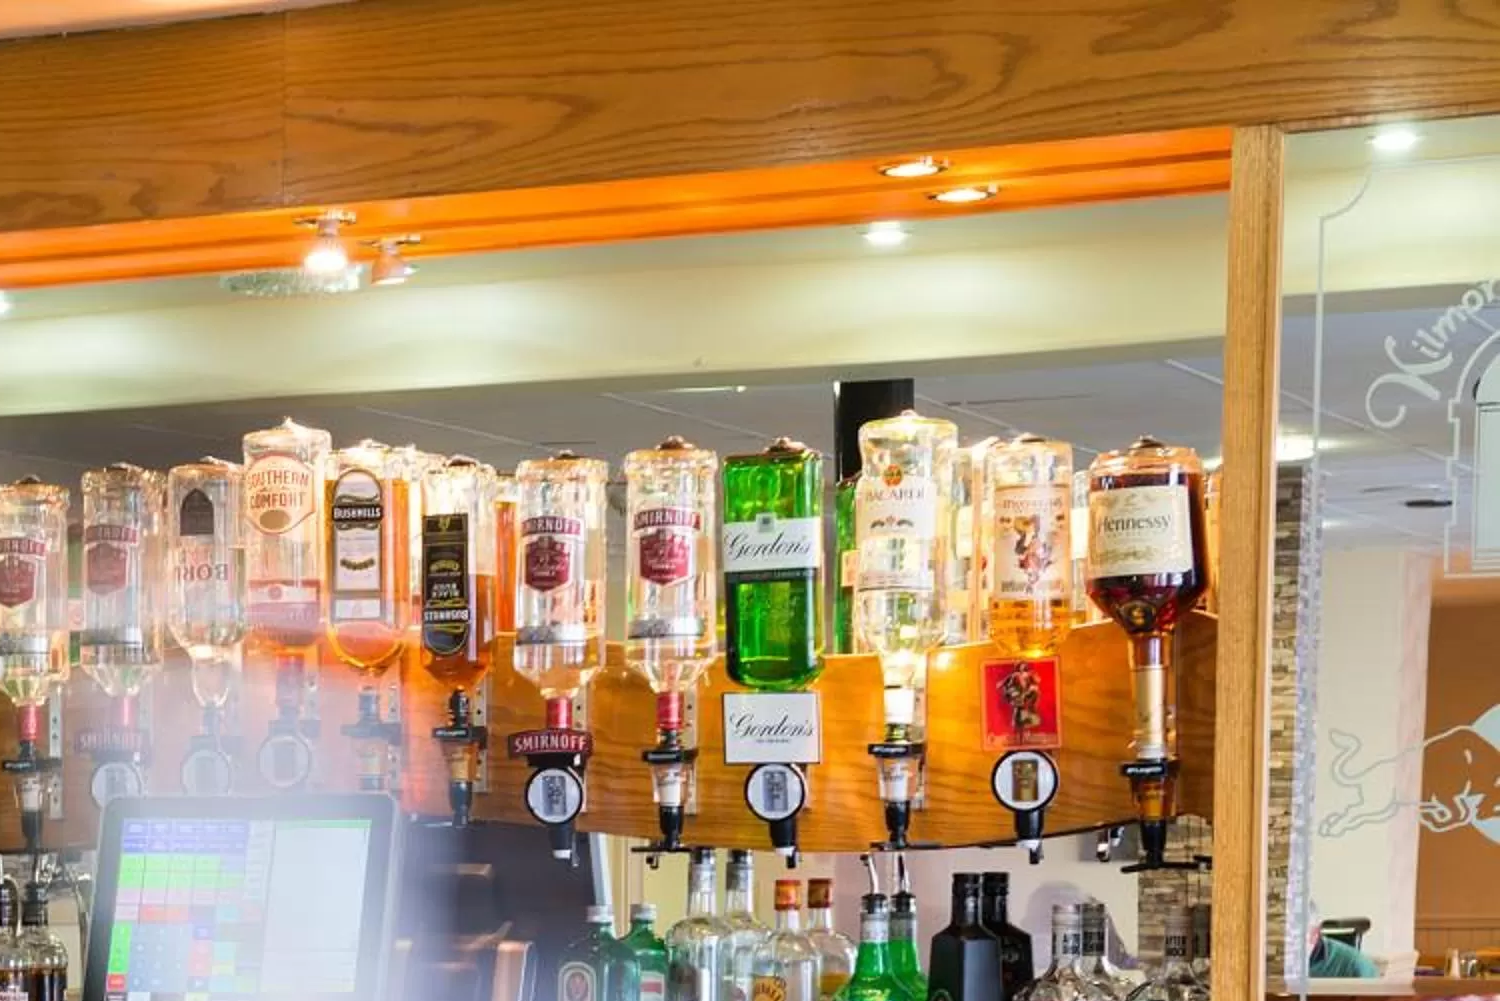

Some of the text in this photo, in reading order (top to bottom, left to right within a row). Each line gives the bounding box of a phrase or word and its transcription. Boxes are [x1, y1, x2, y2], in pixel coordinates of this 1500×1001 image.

[333, 506, 381, 519] BUSHMILLS
[1099, 514, 1172, 534] Hennessy
[724, 531, 810, 561] Gordon's
[729, 712, 814, 739] Gordon's
[515, 734, 588, 753] SMIRNOFF
